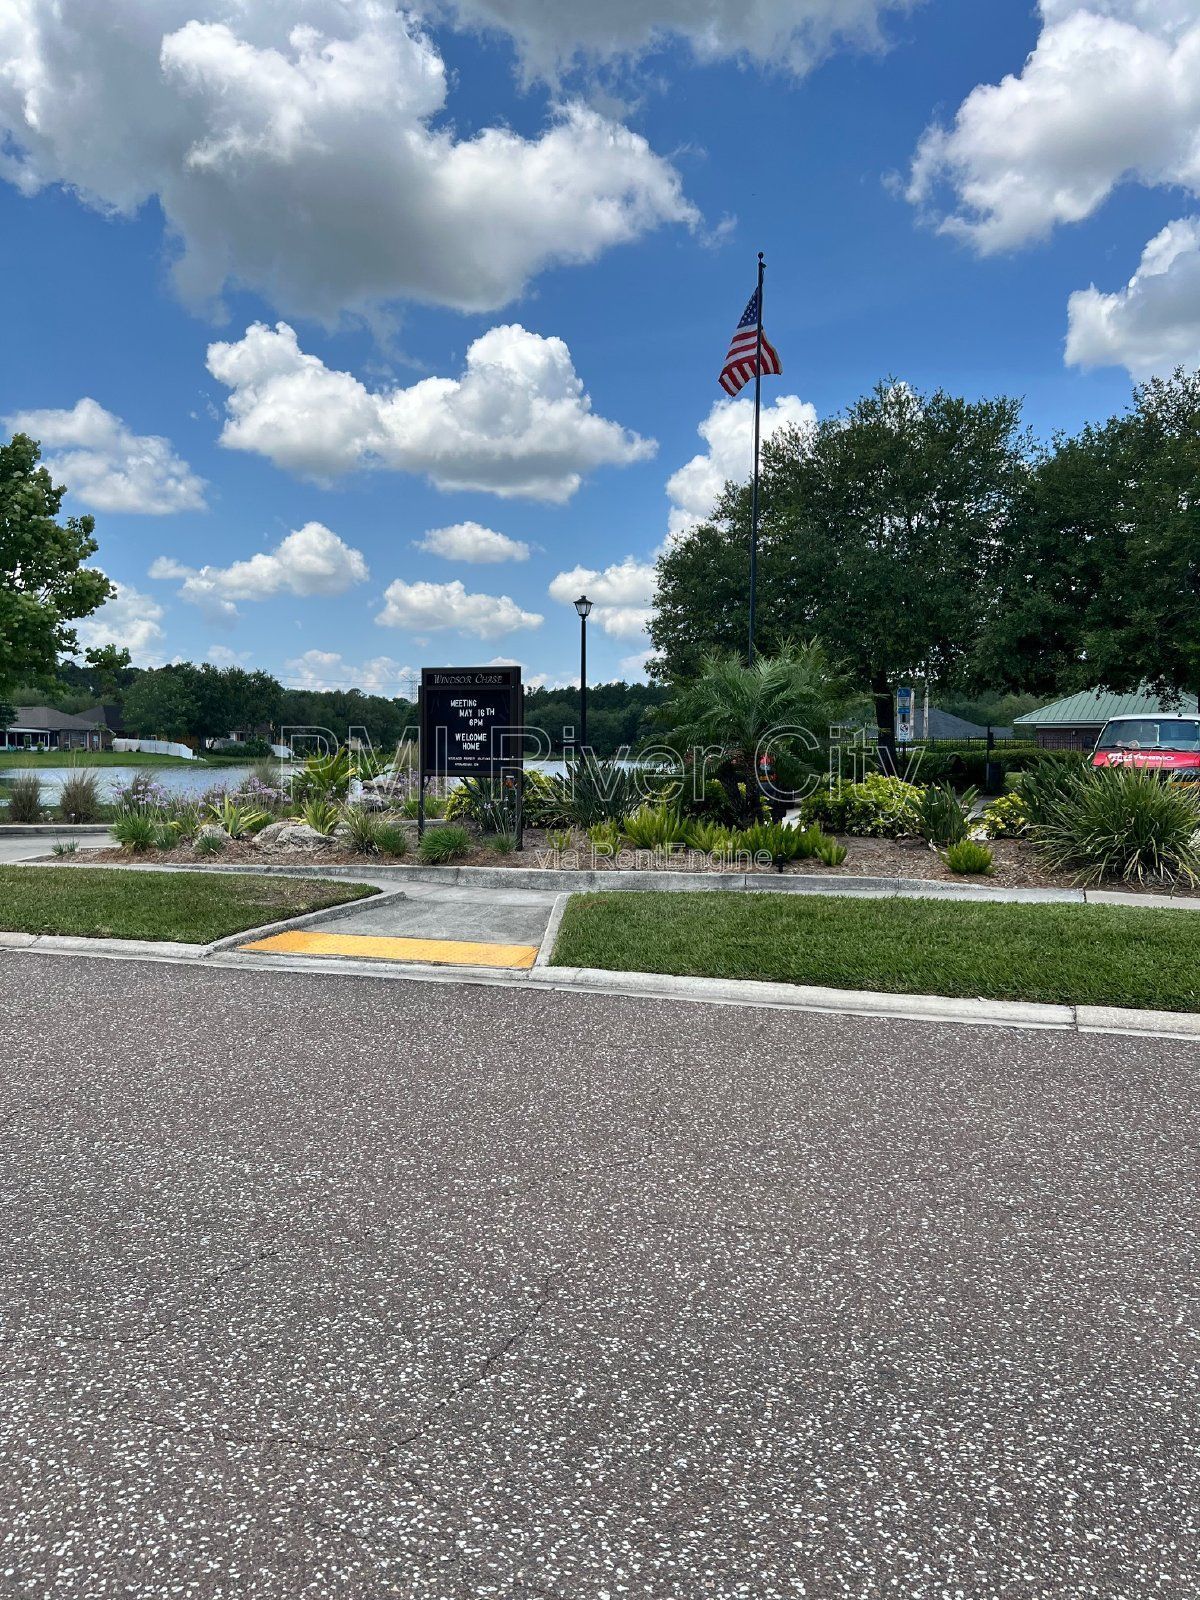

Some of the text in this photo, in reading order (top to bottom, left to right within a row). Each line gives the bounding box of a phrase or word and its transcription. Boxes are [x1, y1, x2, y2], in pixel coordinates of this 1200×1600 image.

[450, 699, 477, 707] MEETING
[459, 708, 472, 717] MAY
[469, 718, 483, 726] 6PM
[455, 732, 487, 741] WELCOME
[462, 742, 480, 750] HOME
